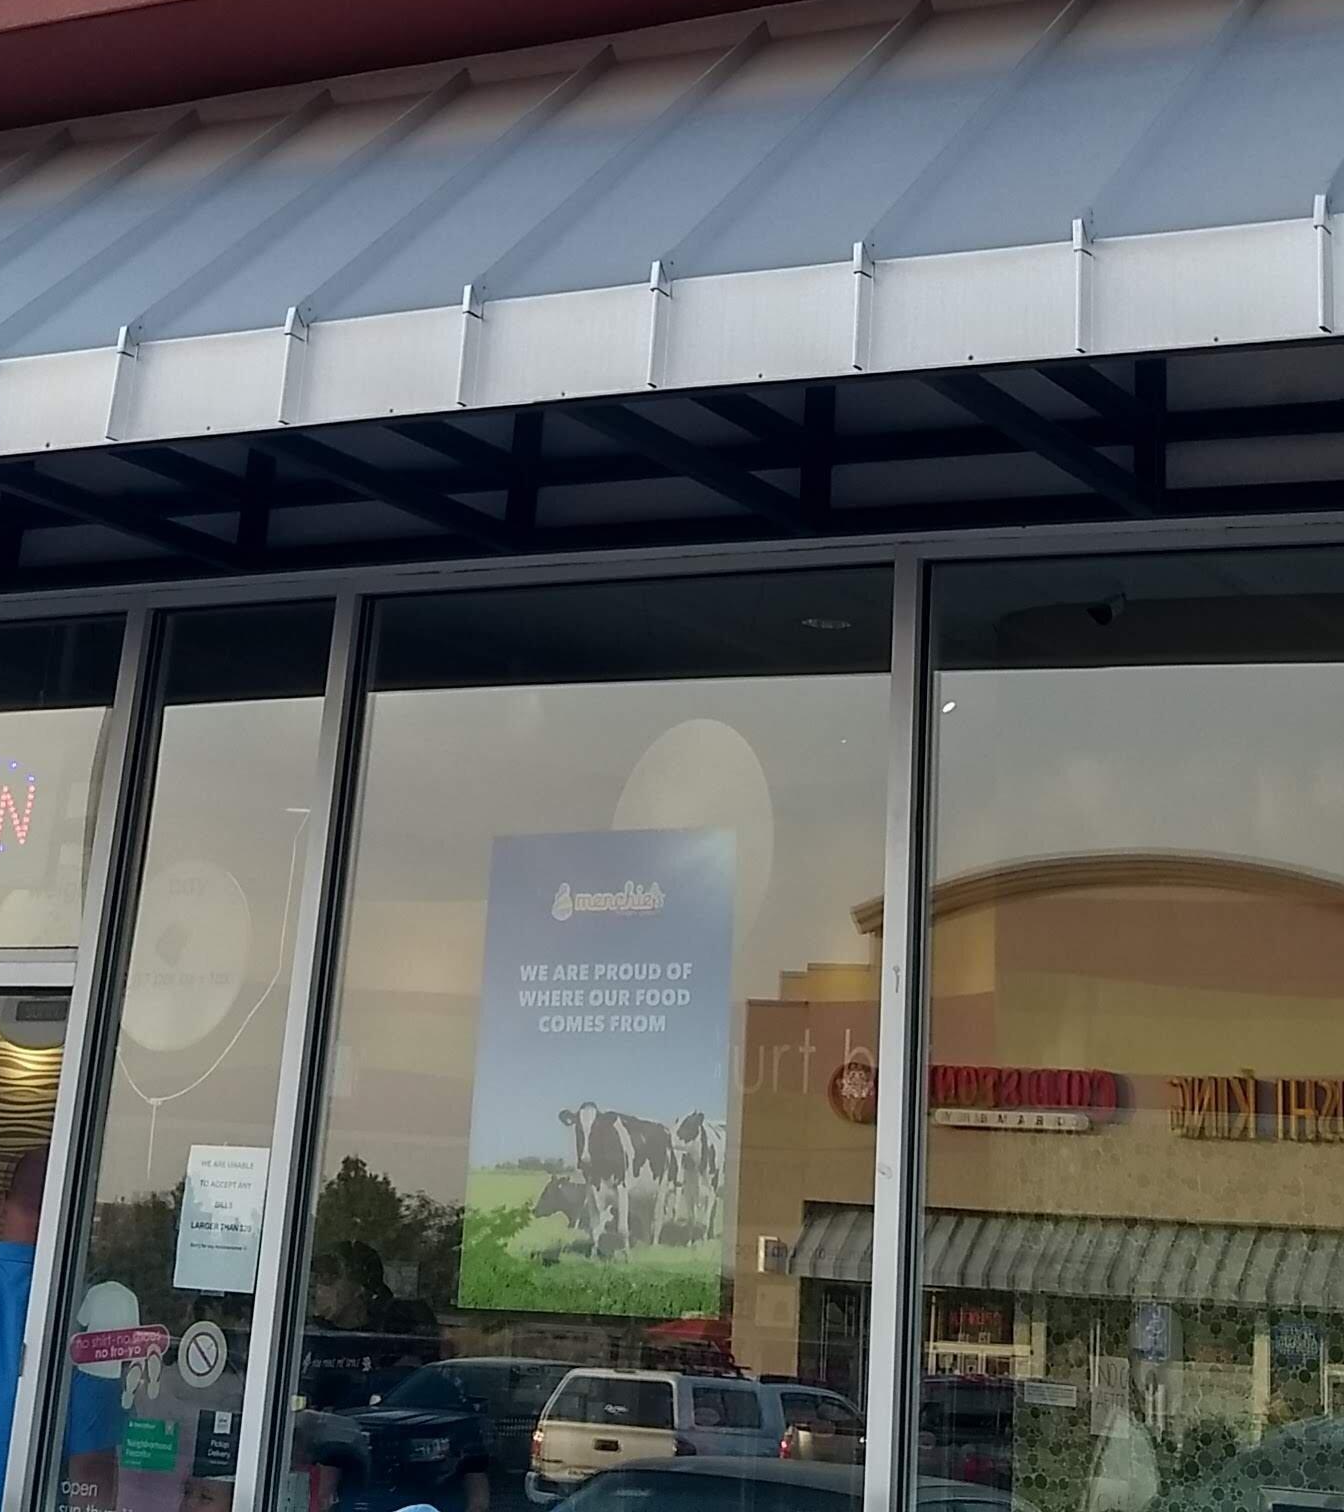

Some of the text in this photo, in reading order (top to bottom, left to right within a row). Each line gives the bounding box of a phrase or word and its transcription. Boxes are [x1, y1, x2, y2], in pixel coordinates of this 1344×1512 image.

[520, 962, 693, 981] WE ARE PROUD OF
[519, 988, 691, 1007] WHERE OUR FOOD
[539, 1015, 666, 1033] COMES FROM
[95, 1348, 109, 1358] no
[60, 1480, 98, 1497] open
